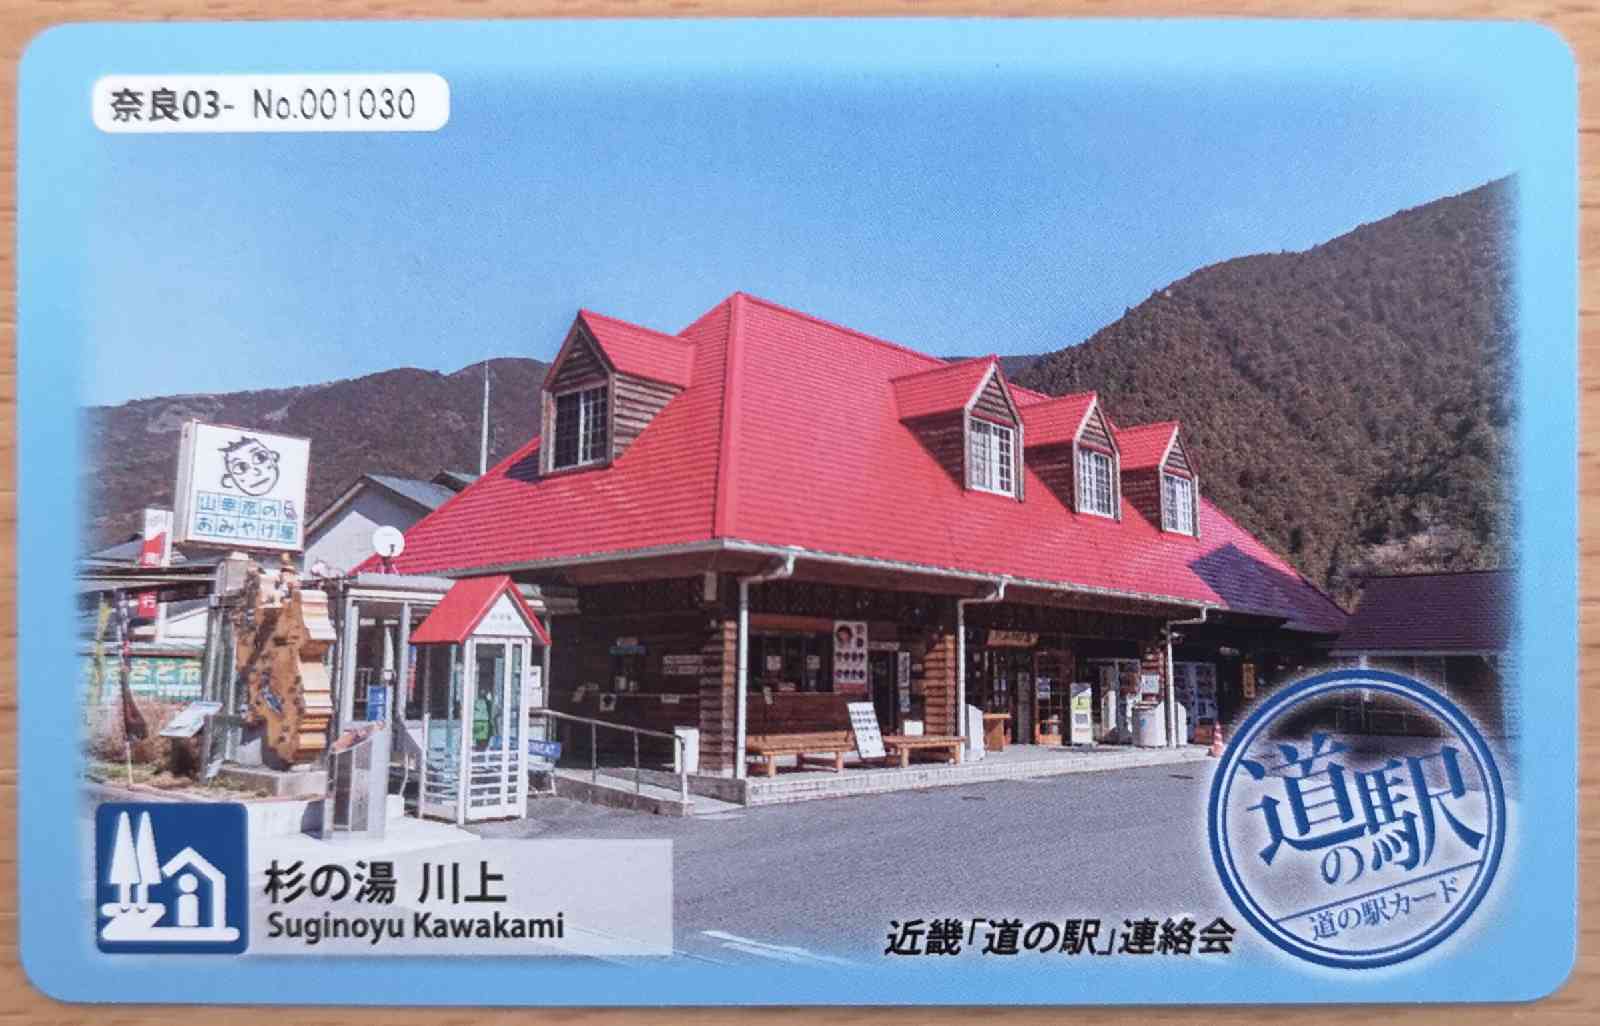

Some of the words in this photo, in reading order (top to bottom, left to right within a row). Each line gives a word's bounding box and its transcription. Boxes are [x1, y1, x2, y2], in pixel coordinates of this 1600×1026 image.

[110, 88, 235, 122] 奈良03-
[253, 88, 415, 120] No.001030
[264, 860, 397, 904] 杉の湯
[418, 861, 507, 904] 川上
[1310, 876, 1459, 941] 道の駅カード
[268, 912, 405, 945] Suginoyu
[413, 912, 565, 938] Kawakami
[885, 917, 1237, 956] 近畿「道の駅」連絡会
